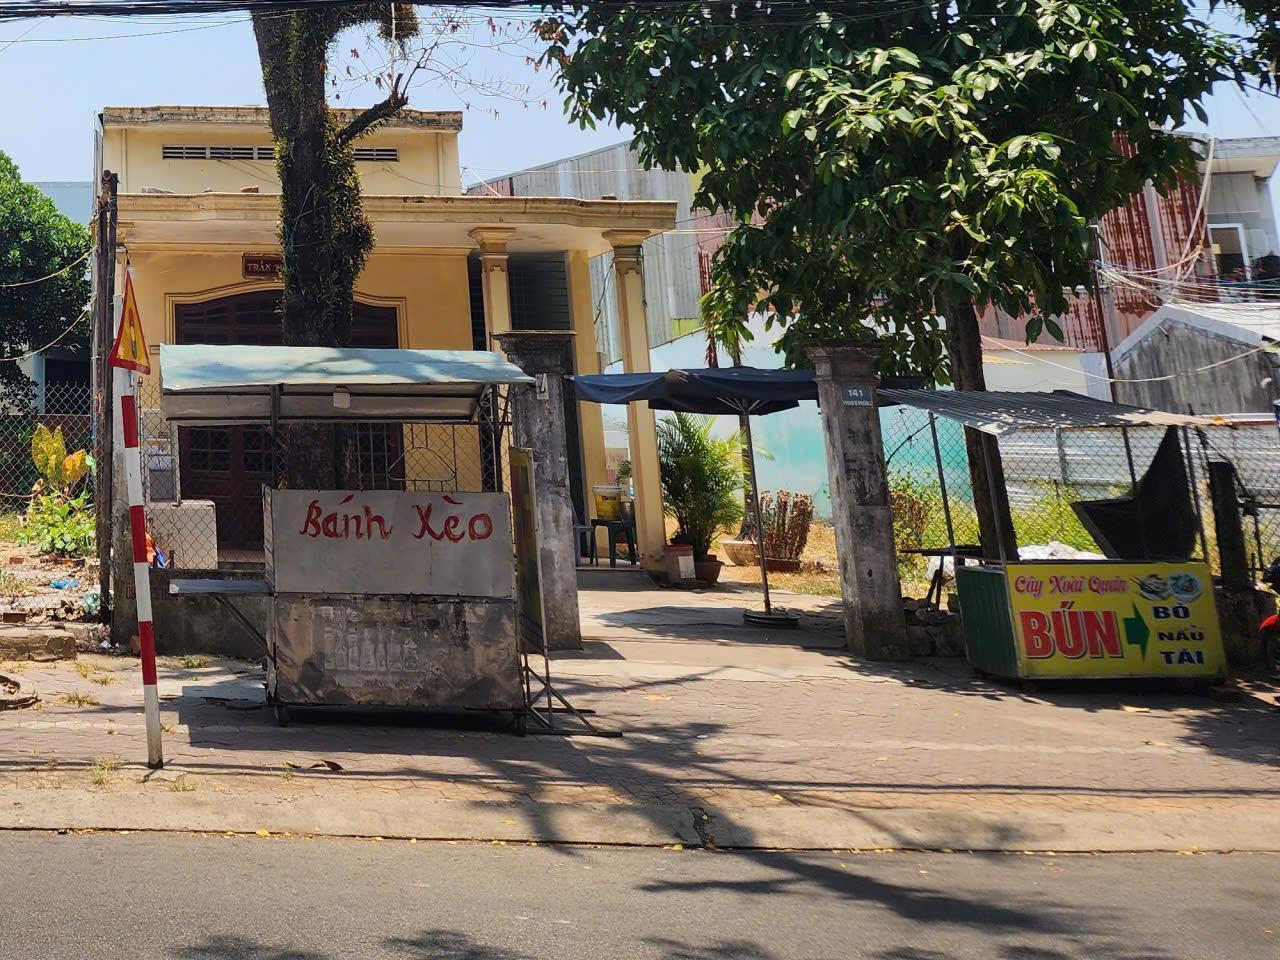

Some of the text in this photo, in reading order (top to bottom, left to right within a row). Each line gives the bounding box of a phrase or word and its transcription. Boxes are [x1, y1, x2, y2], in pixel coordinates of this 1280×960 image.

[848, 389, 864, 397] 141
[299, 494, 493, 543] Bánh Xèo
[1015, 575, 1043, 598] Cây
[1049, 575, 1084, 593] Xoài
[1152, 601, 1191, 619] BÒ
[1019, 601, 1124, 659] BÚN
[1159, 649, 1205, 665] TÁI
